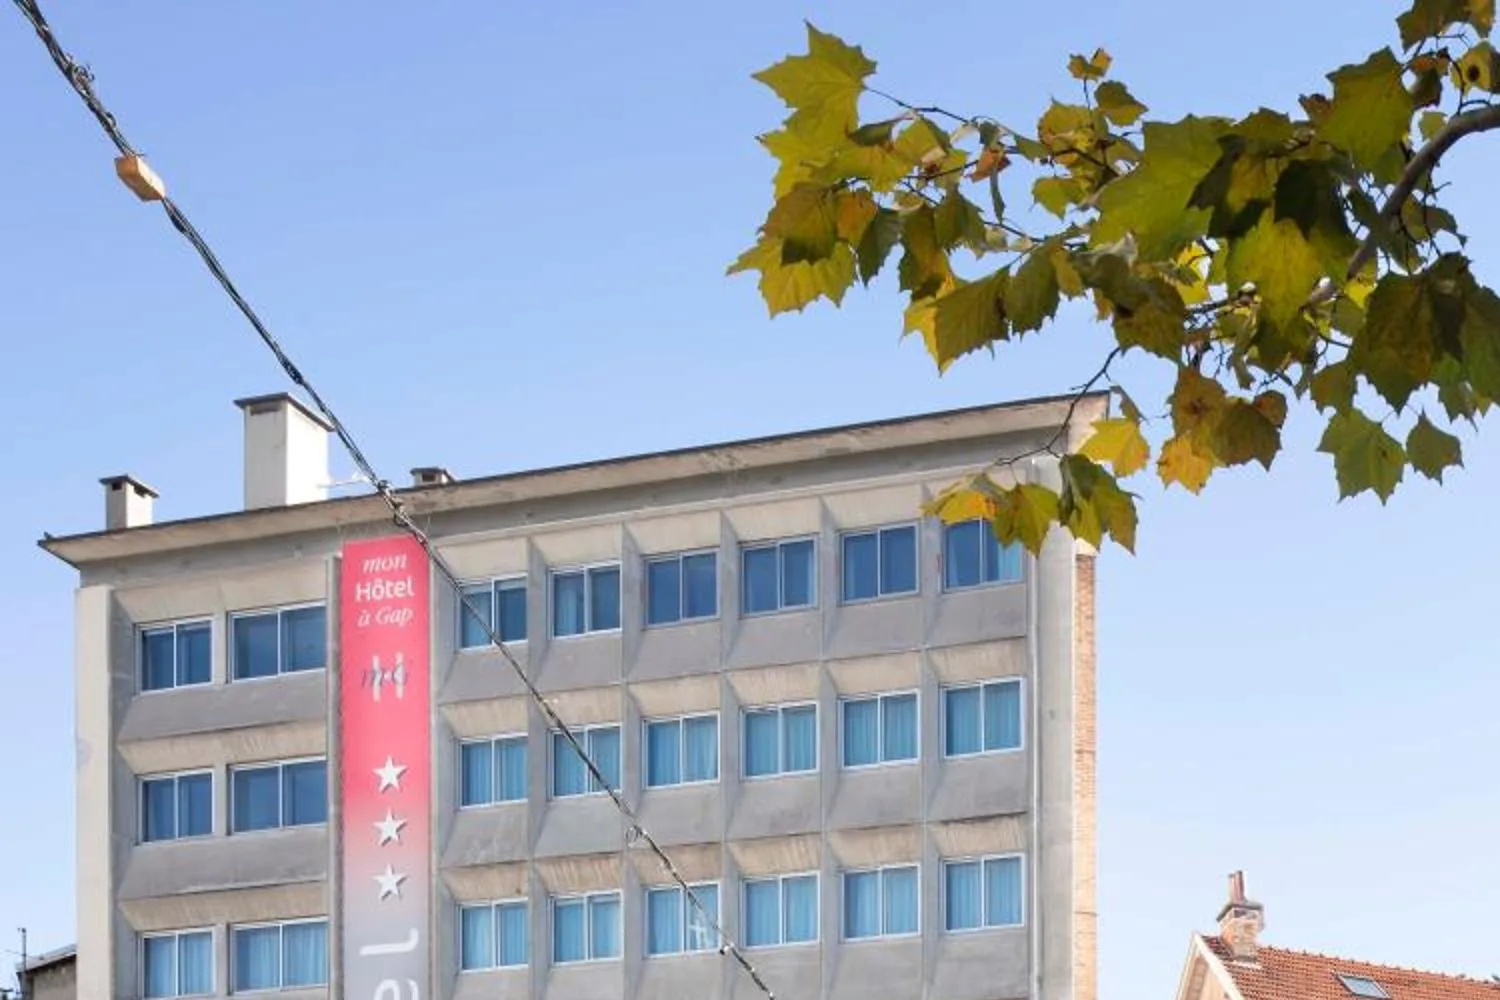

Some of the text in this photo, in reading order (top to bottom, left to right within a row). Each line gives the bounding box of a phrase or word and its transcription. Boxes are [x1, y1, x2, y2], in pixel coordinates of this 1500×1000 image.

[362, 553, 407, 574] mon
[354, 575, 415, 602] Hôtel
[357, 605, 413, 629] à Gap
